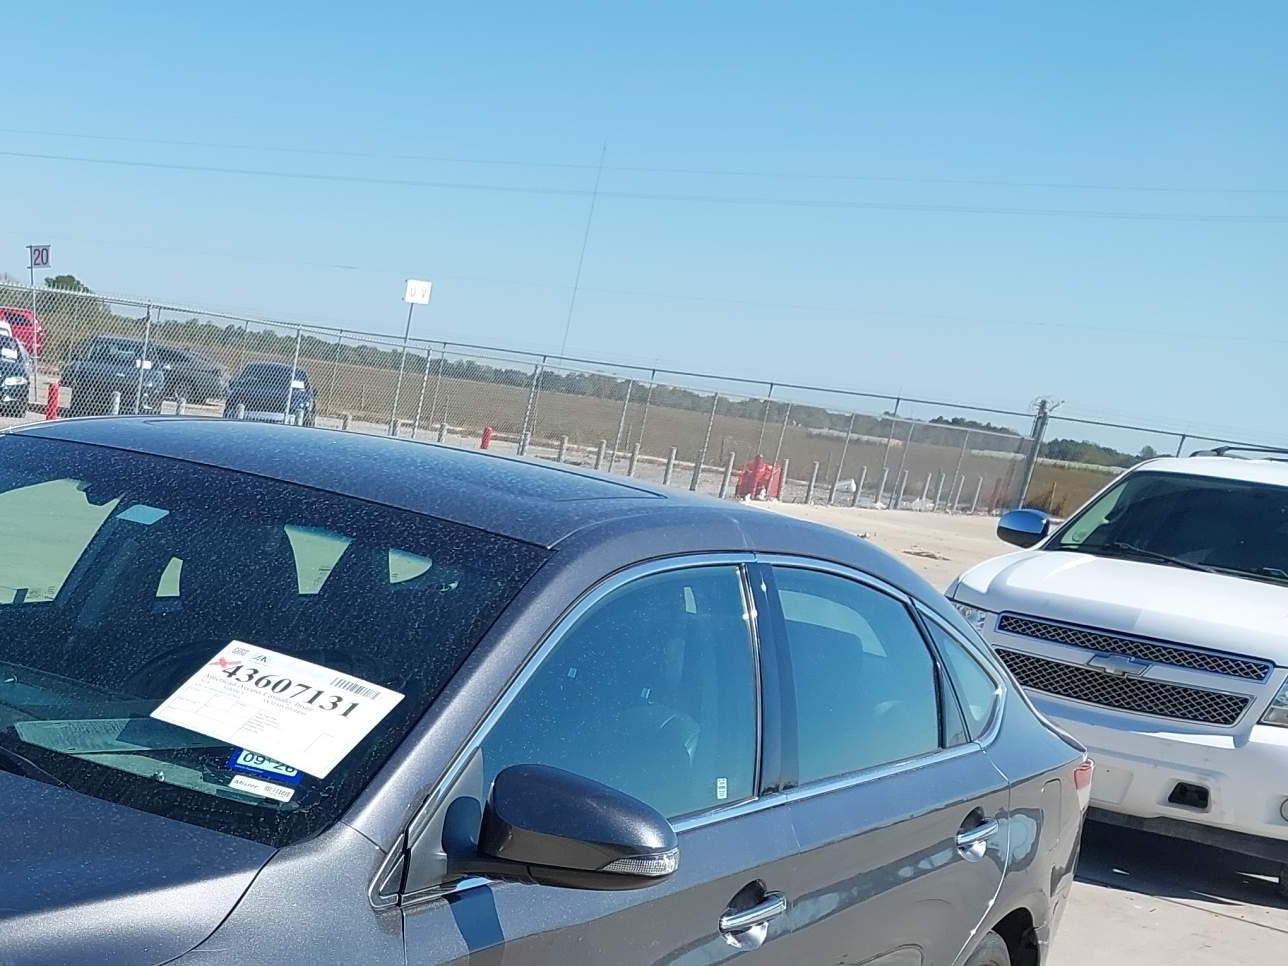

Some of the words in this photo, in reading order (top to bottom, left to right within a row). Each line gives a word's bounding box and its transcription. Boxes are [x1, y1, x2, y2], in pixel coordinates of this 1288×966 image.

[33, 247, 49, 266] 20
[222, 664, 360, 718] 43607131
[242, 752, 266, 766] 09
